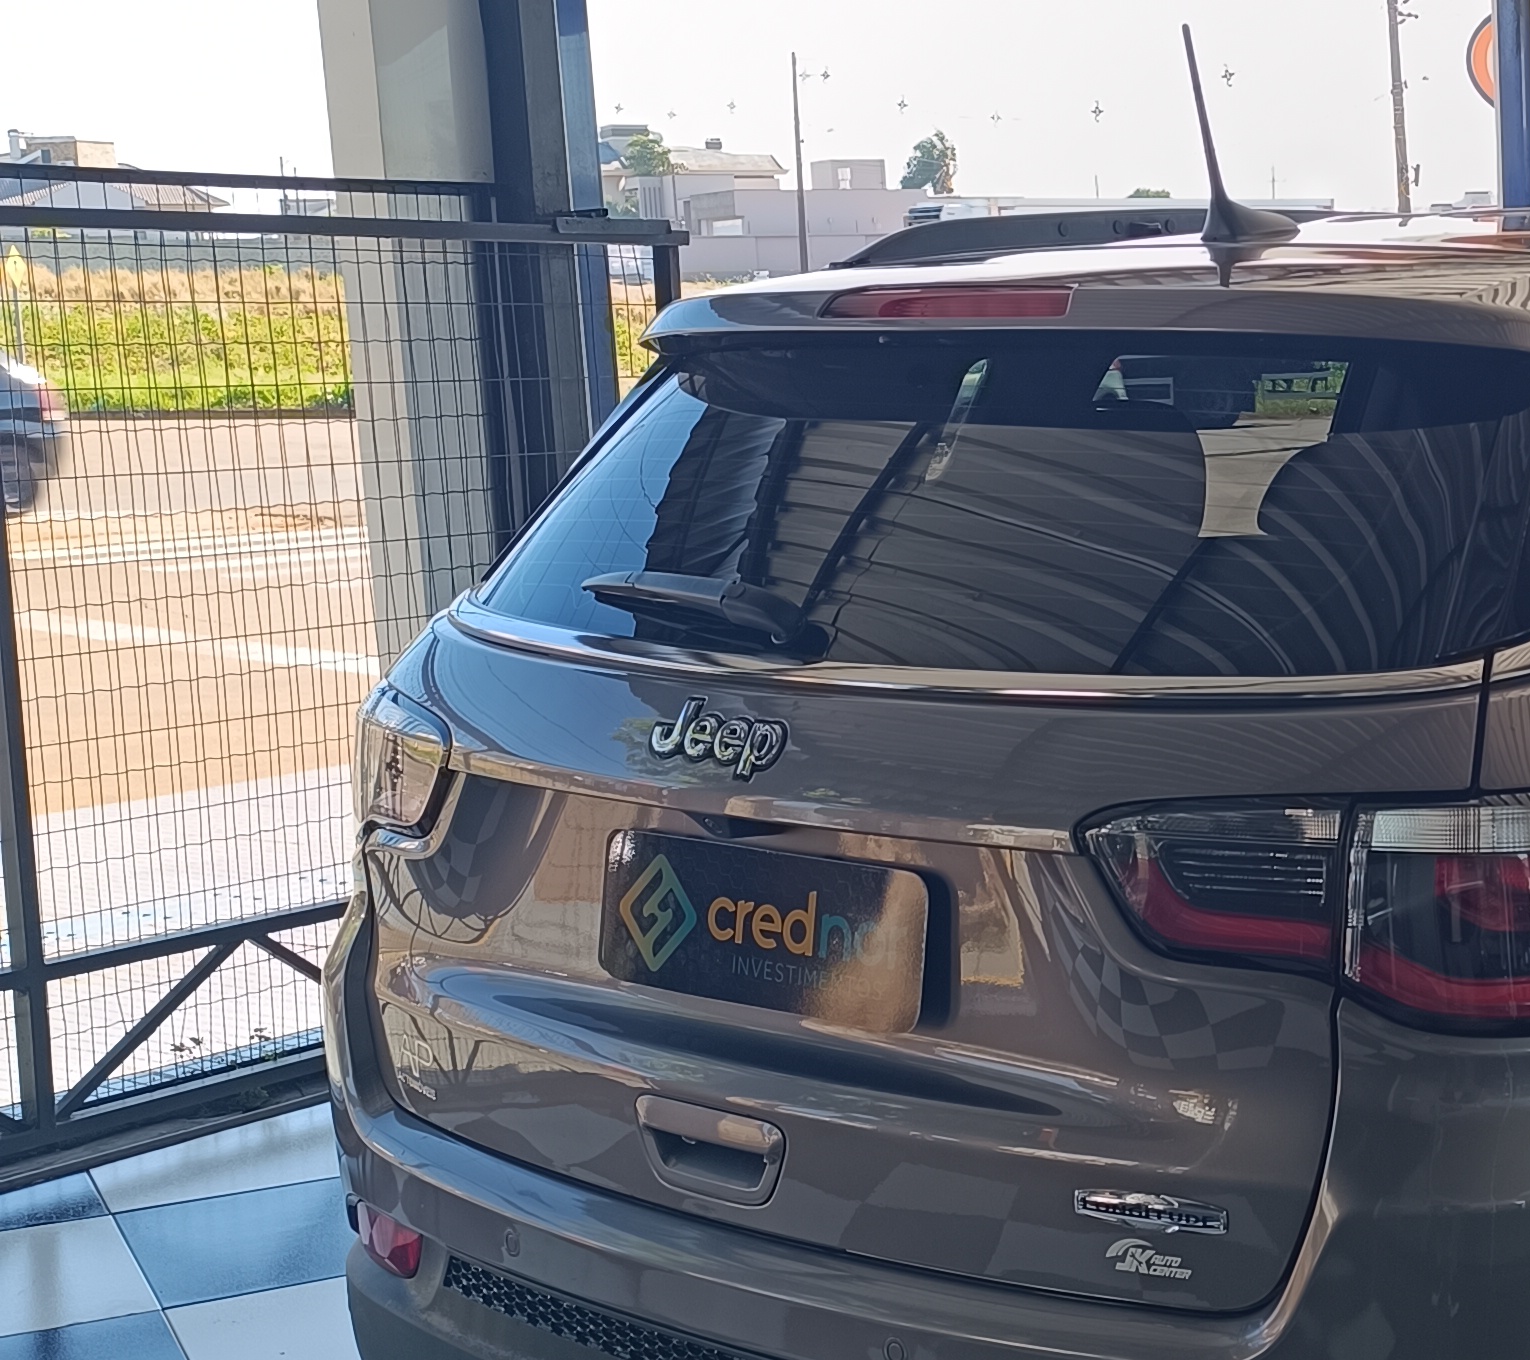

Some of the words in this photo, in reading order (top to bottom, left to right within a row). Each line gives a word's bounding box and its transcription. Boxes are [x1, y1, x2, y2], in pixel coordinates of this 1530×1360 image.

[649, 696, 788, 782] Jeep
[731, 952, 886, 1001] INVESTIMENTOS
[1149, 1265, 1192, 1280] CENTER
[1150, 1254, 1182, 1267] AUTO
